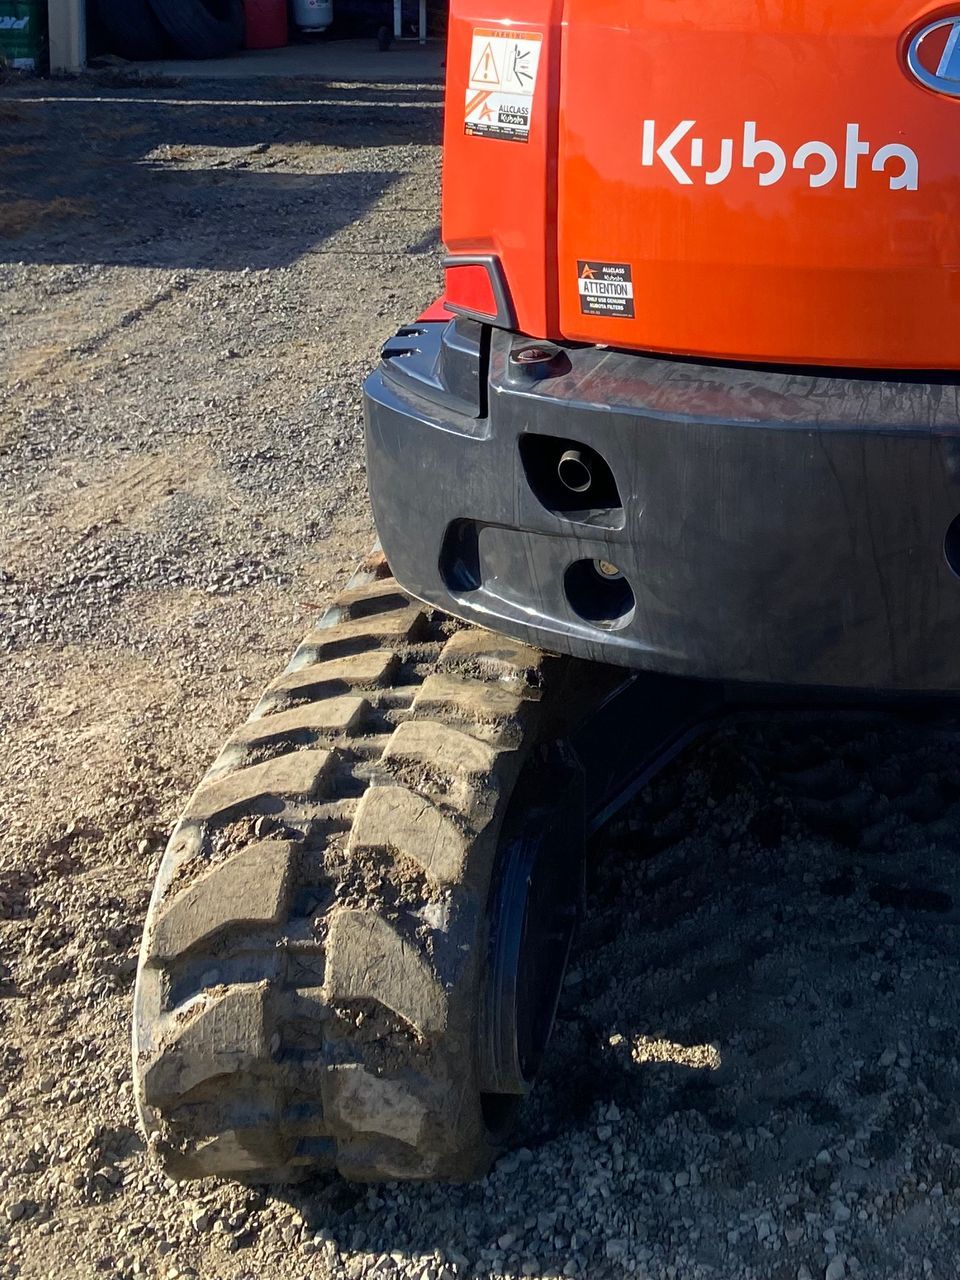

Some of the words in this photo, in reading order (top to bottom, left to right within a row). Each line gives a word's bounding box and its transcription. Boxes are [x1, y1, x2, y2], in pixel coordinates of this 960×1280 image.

[498, 104, 529, 115] ALLCLASS
[641, 119, 919, 191] Kubota
[584, 281, 627, 296] ATTENTION
